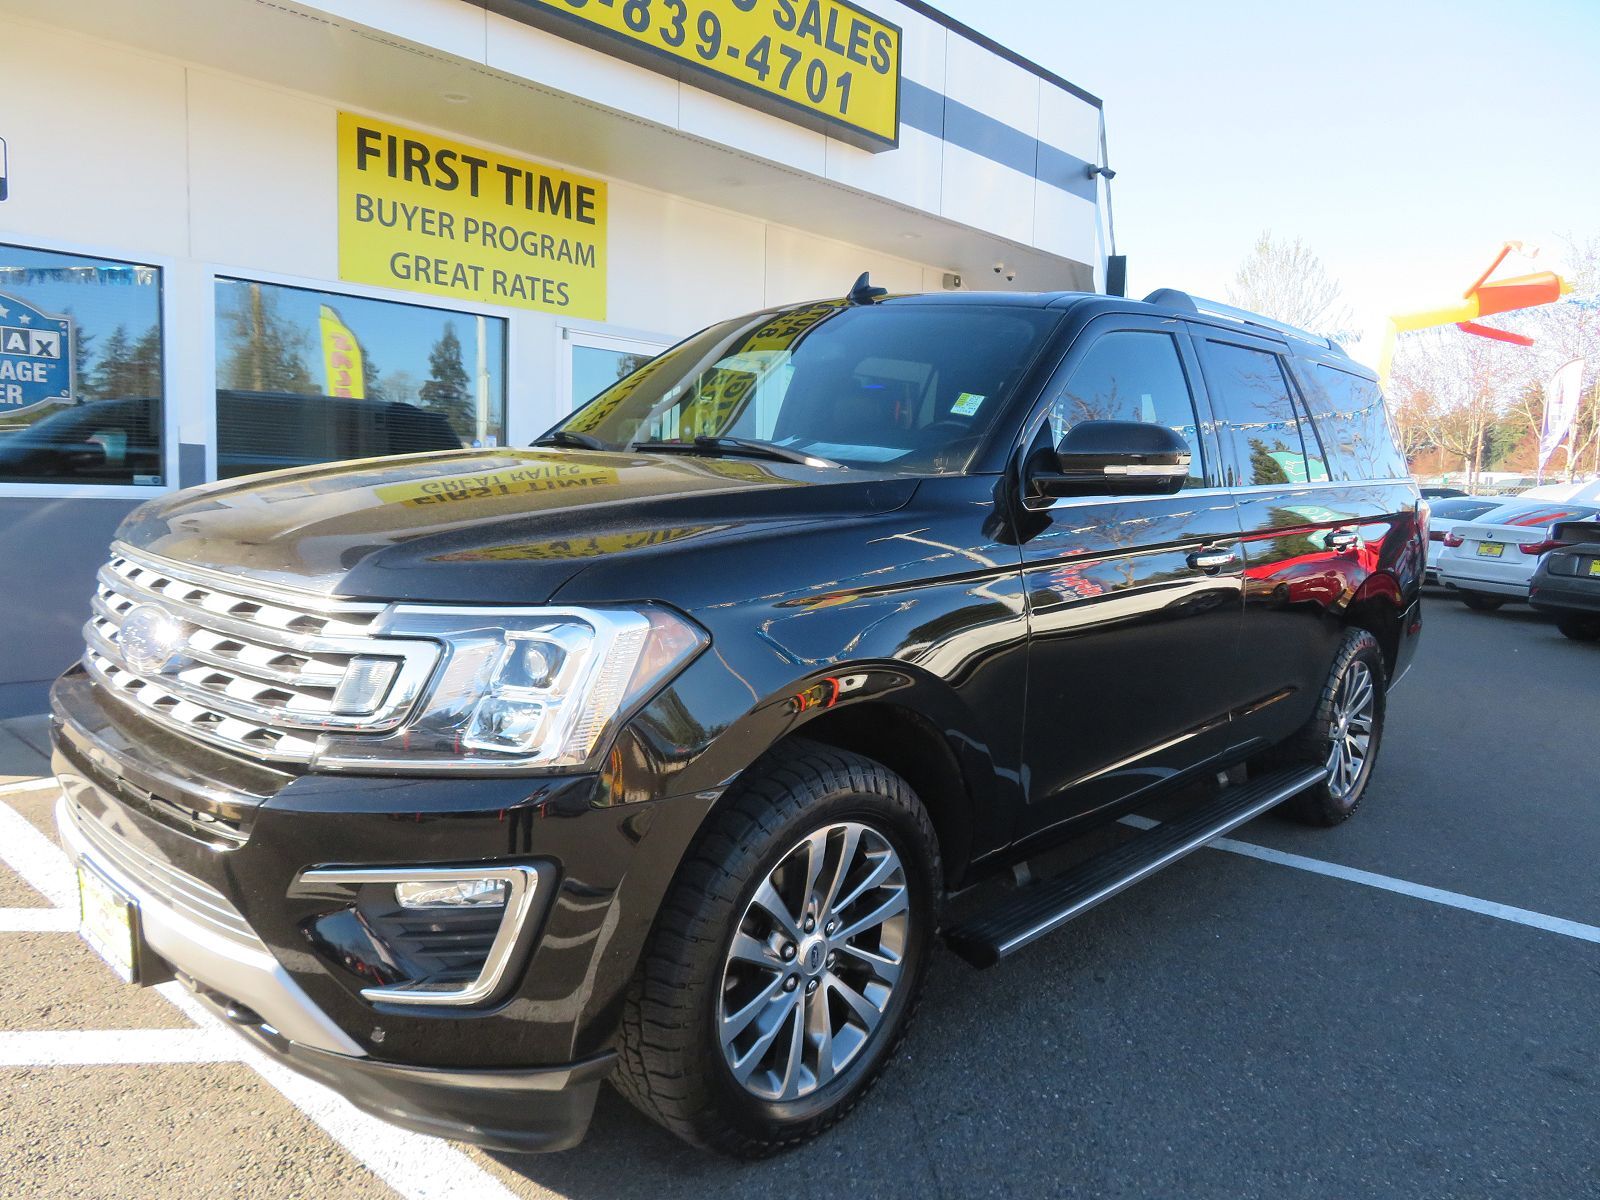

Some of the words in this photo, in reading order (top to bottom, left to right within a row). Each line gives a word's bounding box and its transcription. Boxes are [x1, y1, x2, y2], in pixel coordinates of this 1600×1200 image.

[563, 0, 852, 115] -839-4701
[773, 0, 893, 75] SALES
[356, 127, 488, 198] FIRST
[496, 163, 596, 226] TIME
[356, 193, 455, 240] BUYER
[464, 217, 596, 268] PROGRAM
[390, 252, 484, 291] GREAT
[492, 269, 570, 307] RATES
[0, 360, 48, 383] AGE
